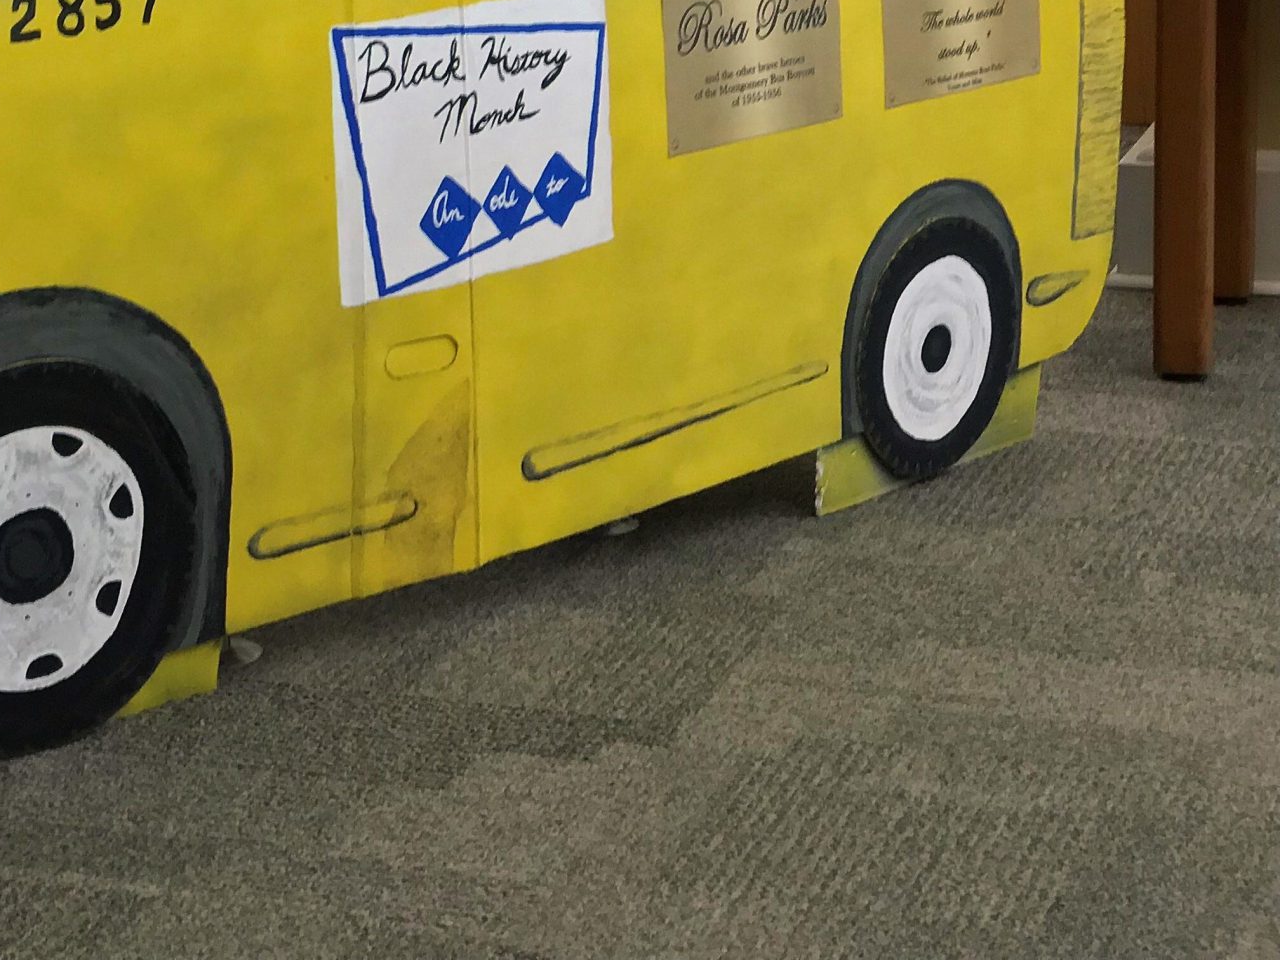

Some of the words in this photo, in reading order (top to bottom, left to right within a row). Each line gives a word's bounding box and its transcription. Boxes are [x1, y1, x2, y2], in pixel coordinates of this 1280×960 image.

[677, 0, 749, 57] Rosa
[920, 8, 944, 33] The
[945, 8, 974, 28] whole
[975, 0, 1006, 20] world
[937, 40, 966, 60] stood
[358, 38, 466, 103] Black
[479, 35, 571, 90] History
[705, 70, 720, 84] and
[721, 67, 734, 80] the
[736, 64, 756, 77] other
[757, 60, 778, 73] brave
[780, 56, 806, 68] heroes
[694, 89, 703, 101] of
[704, 86, 718, 99] the
[719, 78, 769, 97] Montgomery
[770, 73, 785, 85] Bus
[731, 96, 740, 108] of
[434, 88, 542, 144] Month
[432, 190, 465, 229] An
[489, 175, 520, 213] ode
[545, 175, 570, 199] to
